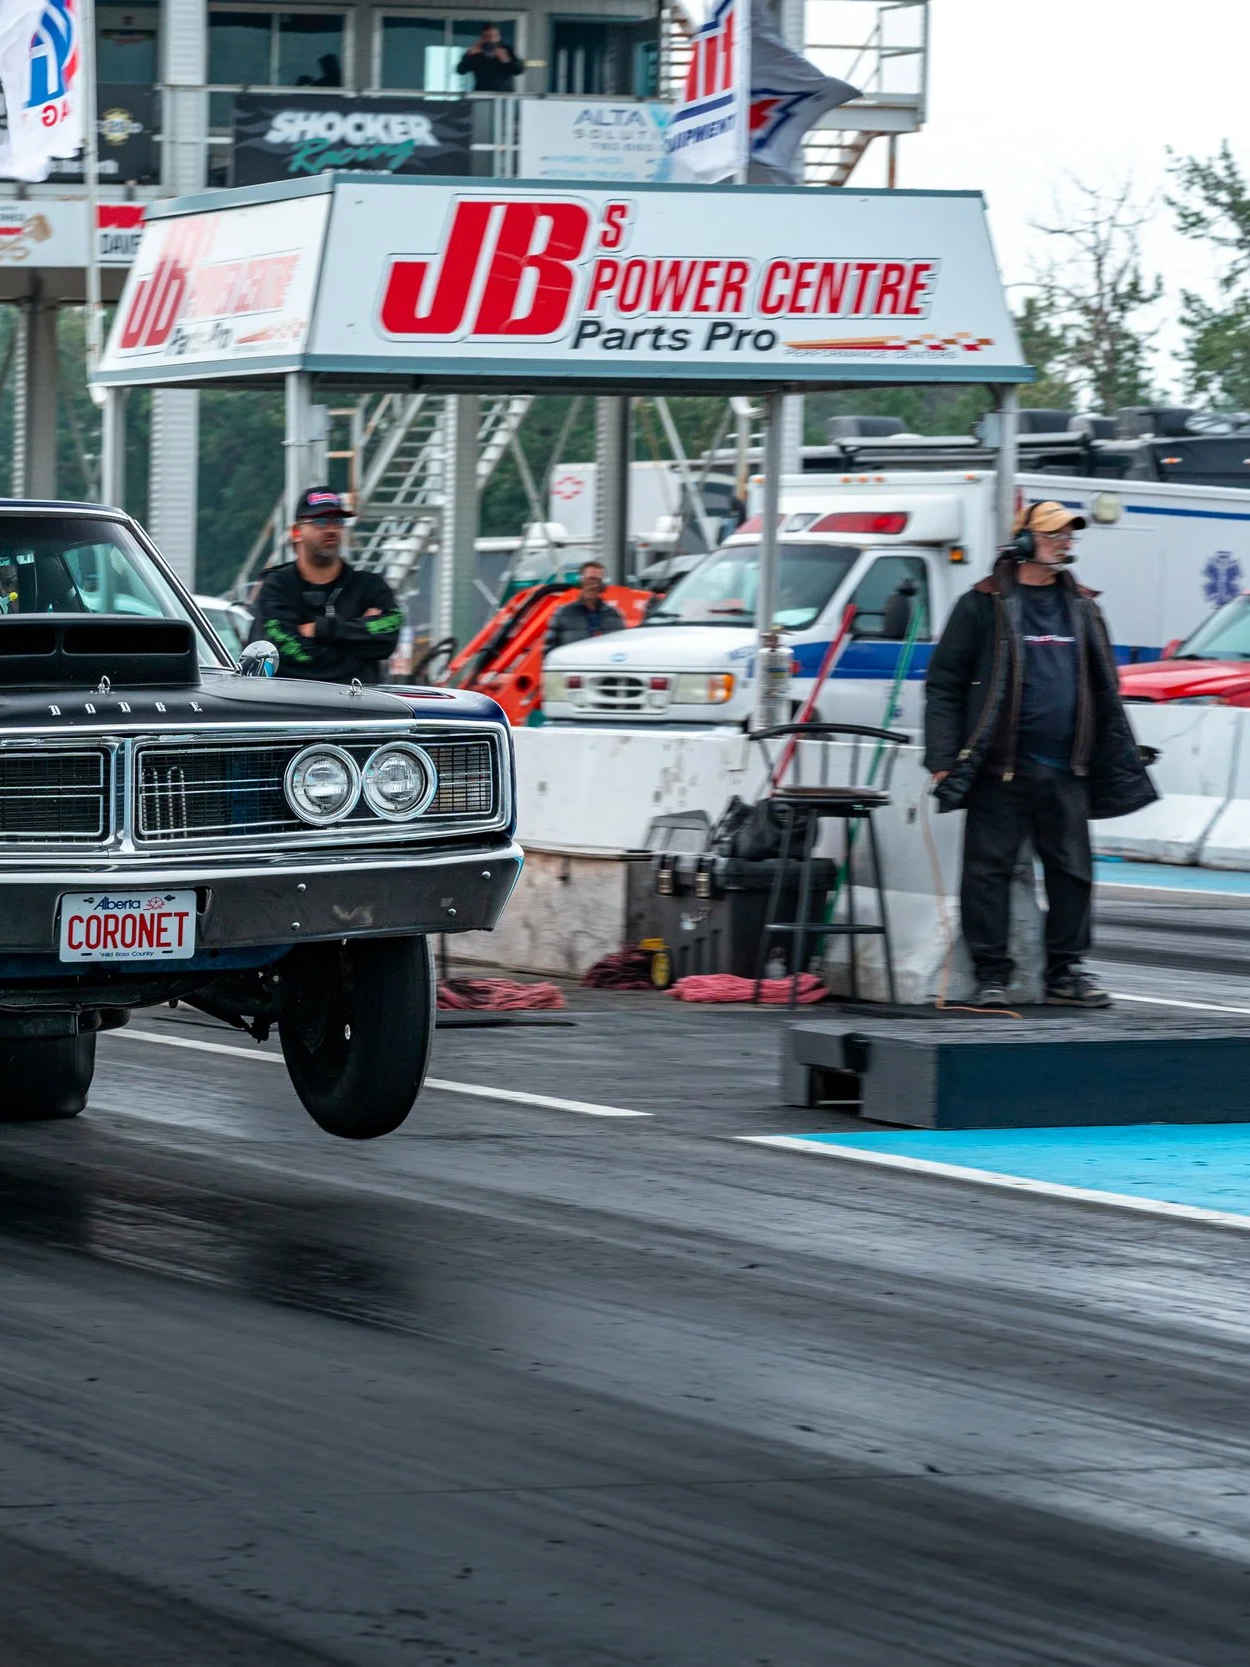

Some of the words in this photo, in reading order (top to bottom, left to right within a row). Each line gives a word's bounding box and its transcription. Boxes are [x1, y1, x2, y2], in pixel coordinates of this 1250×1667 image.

[263, 111, 441, 147] SHOCKER
[573, 108, 648, 127] ALTA
[101, 232, 142, 255] DAVE
[585, 258, 750, 314] POWER
[758, 260, 933, 315] CENTRE
[571, 320, 692, 350] Parts
[702, 321, 778, 351] Pro
[48, 701, 203, 716] DODGE
[93, 896, 141, 910] Alberta
[67, 912, 190, 950] CORONET
